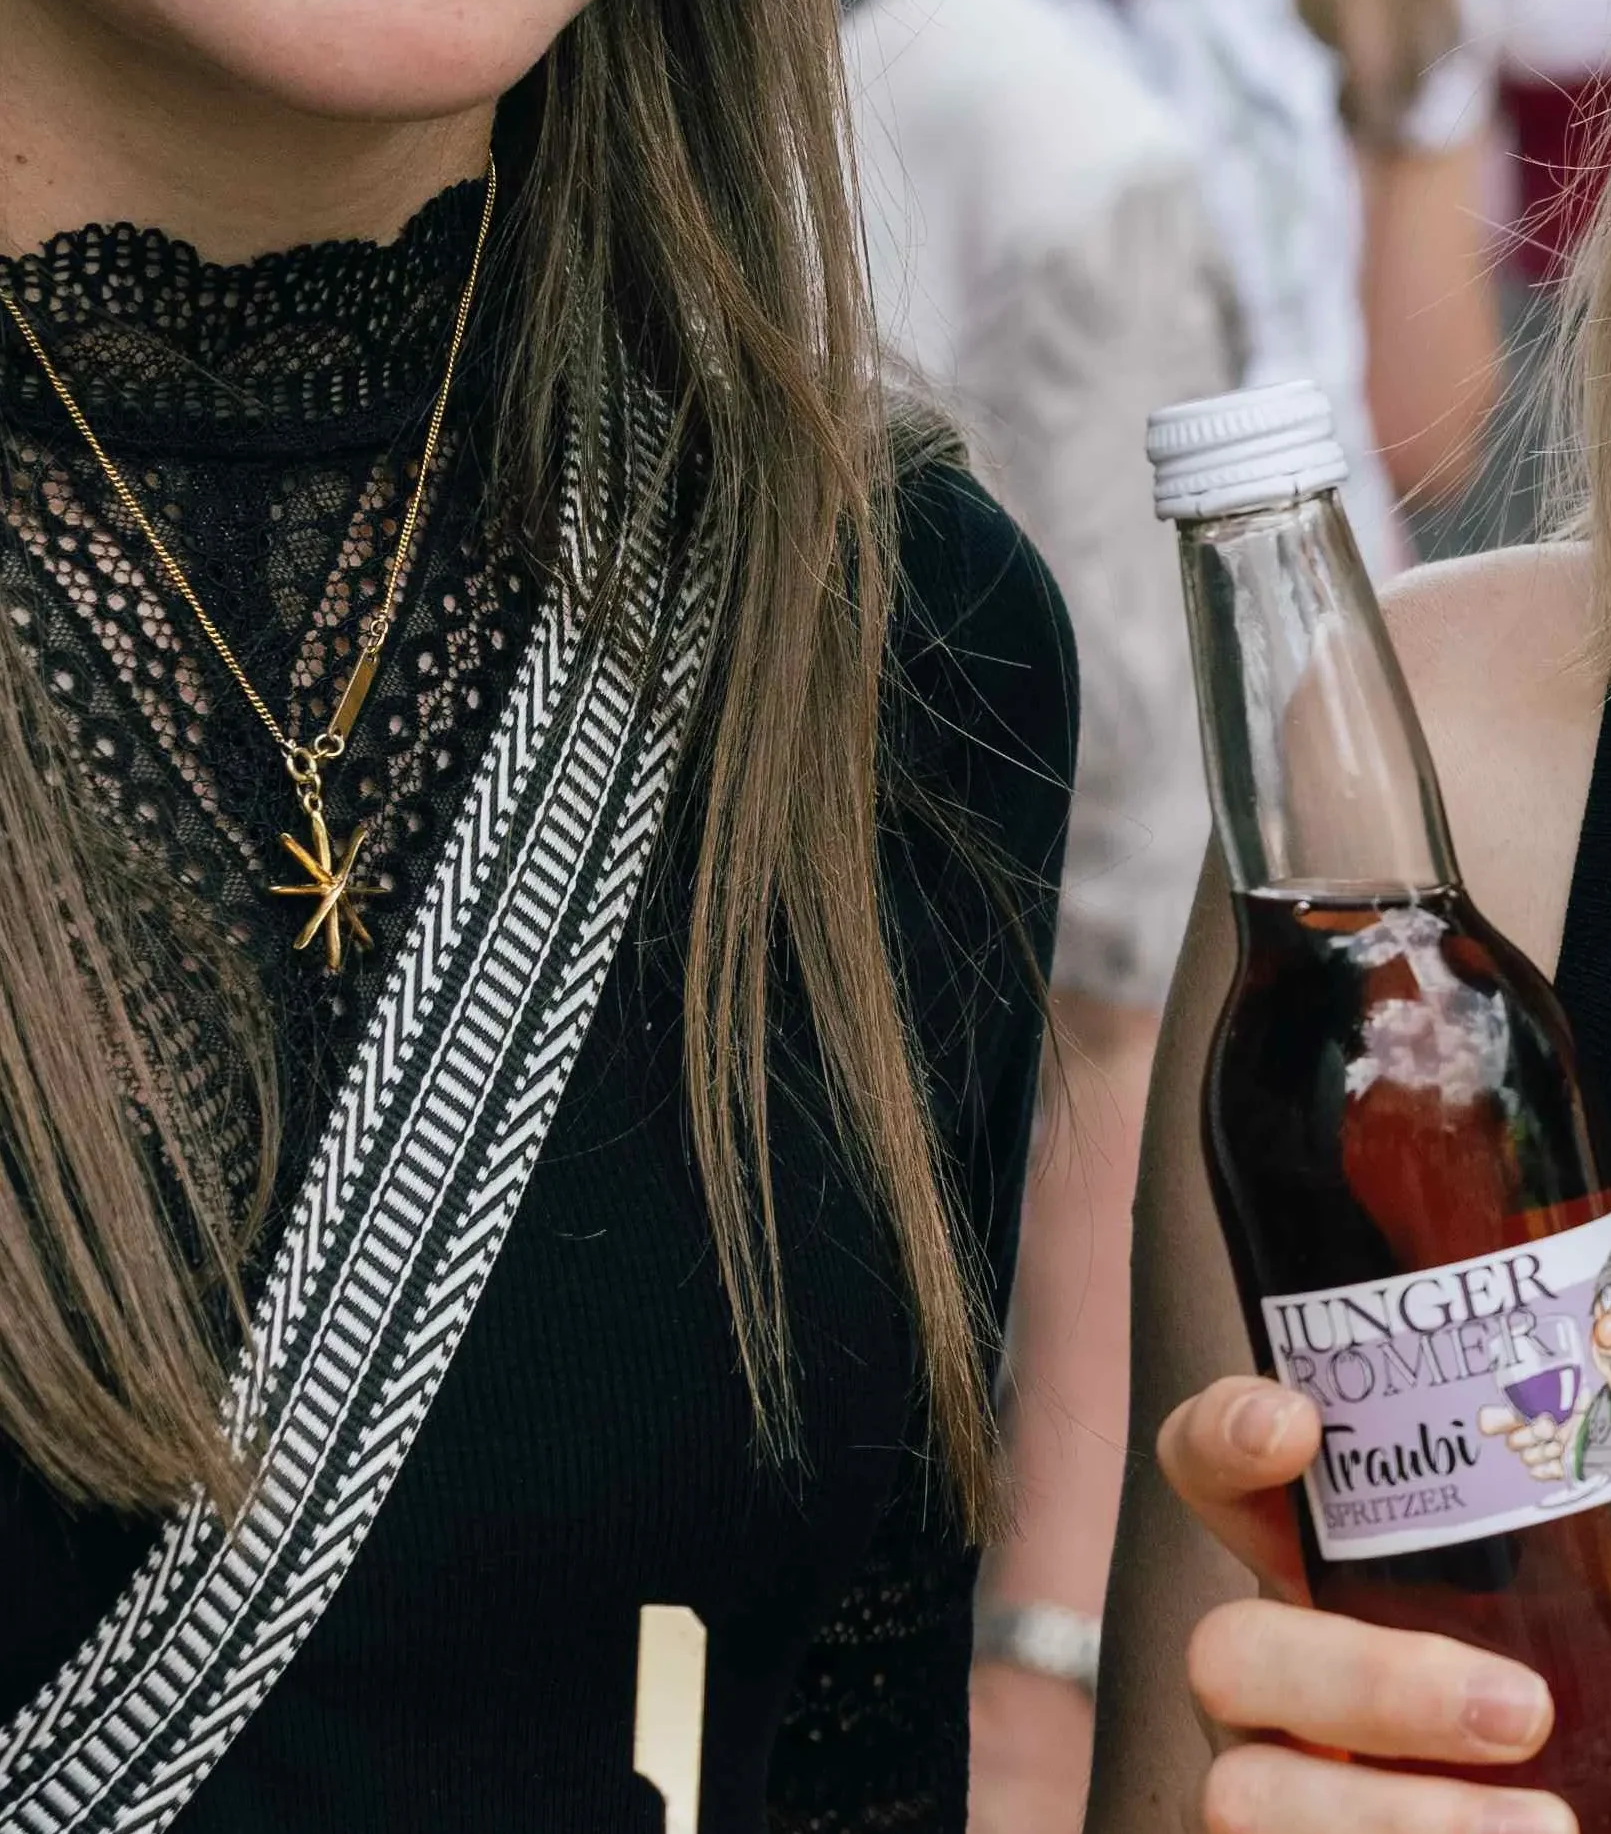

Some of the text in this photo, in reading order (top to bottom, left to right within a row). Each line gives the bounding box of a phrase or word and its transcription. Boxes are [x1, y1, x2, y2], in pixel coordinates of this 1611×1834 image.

[1275, 1253, 1559, 1355] JUNGER
[1321, 1420, 1482, 1495] Traubi
[1323, 1483, 1468, 1530] SPRITZER
